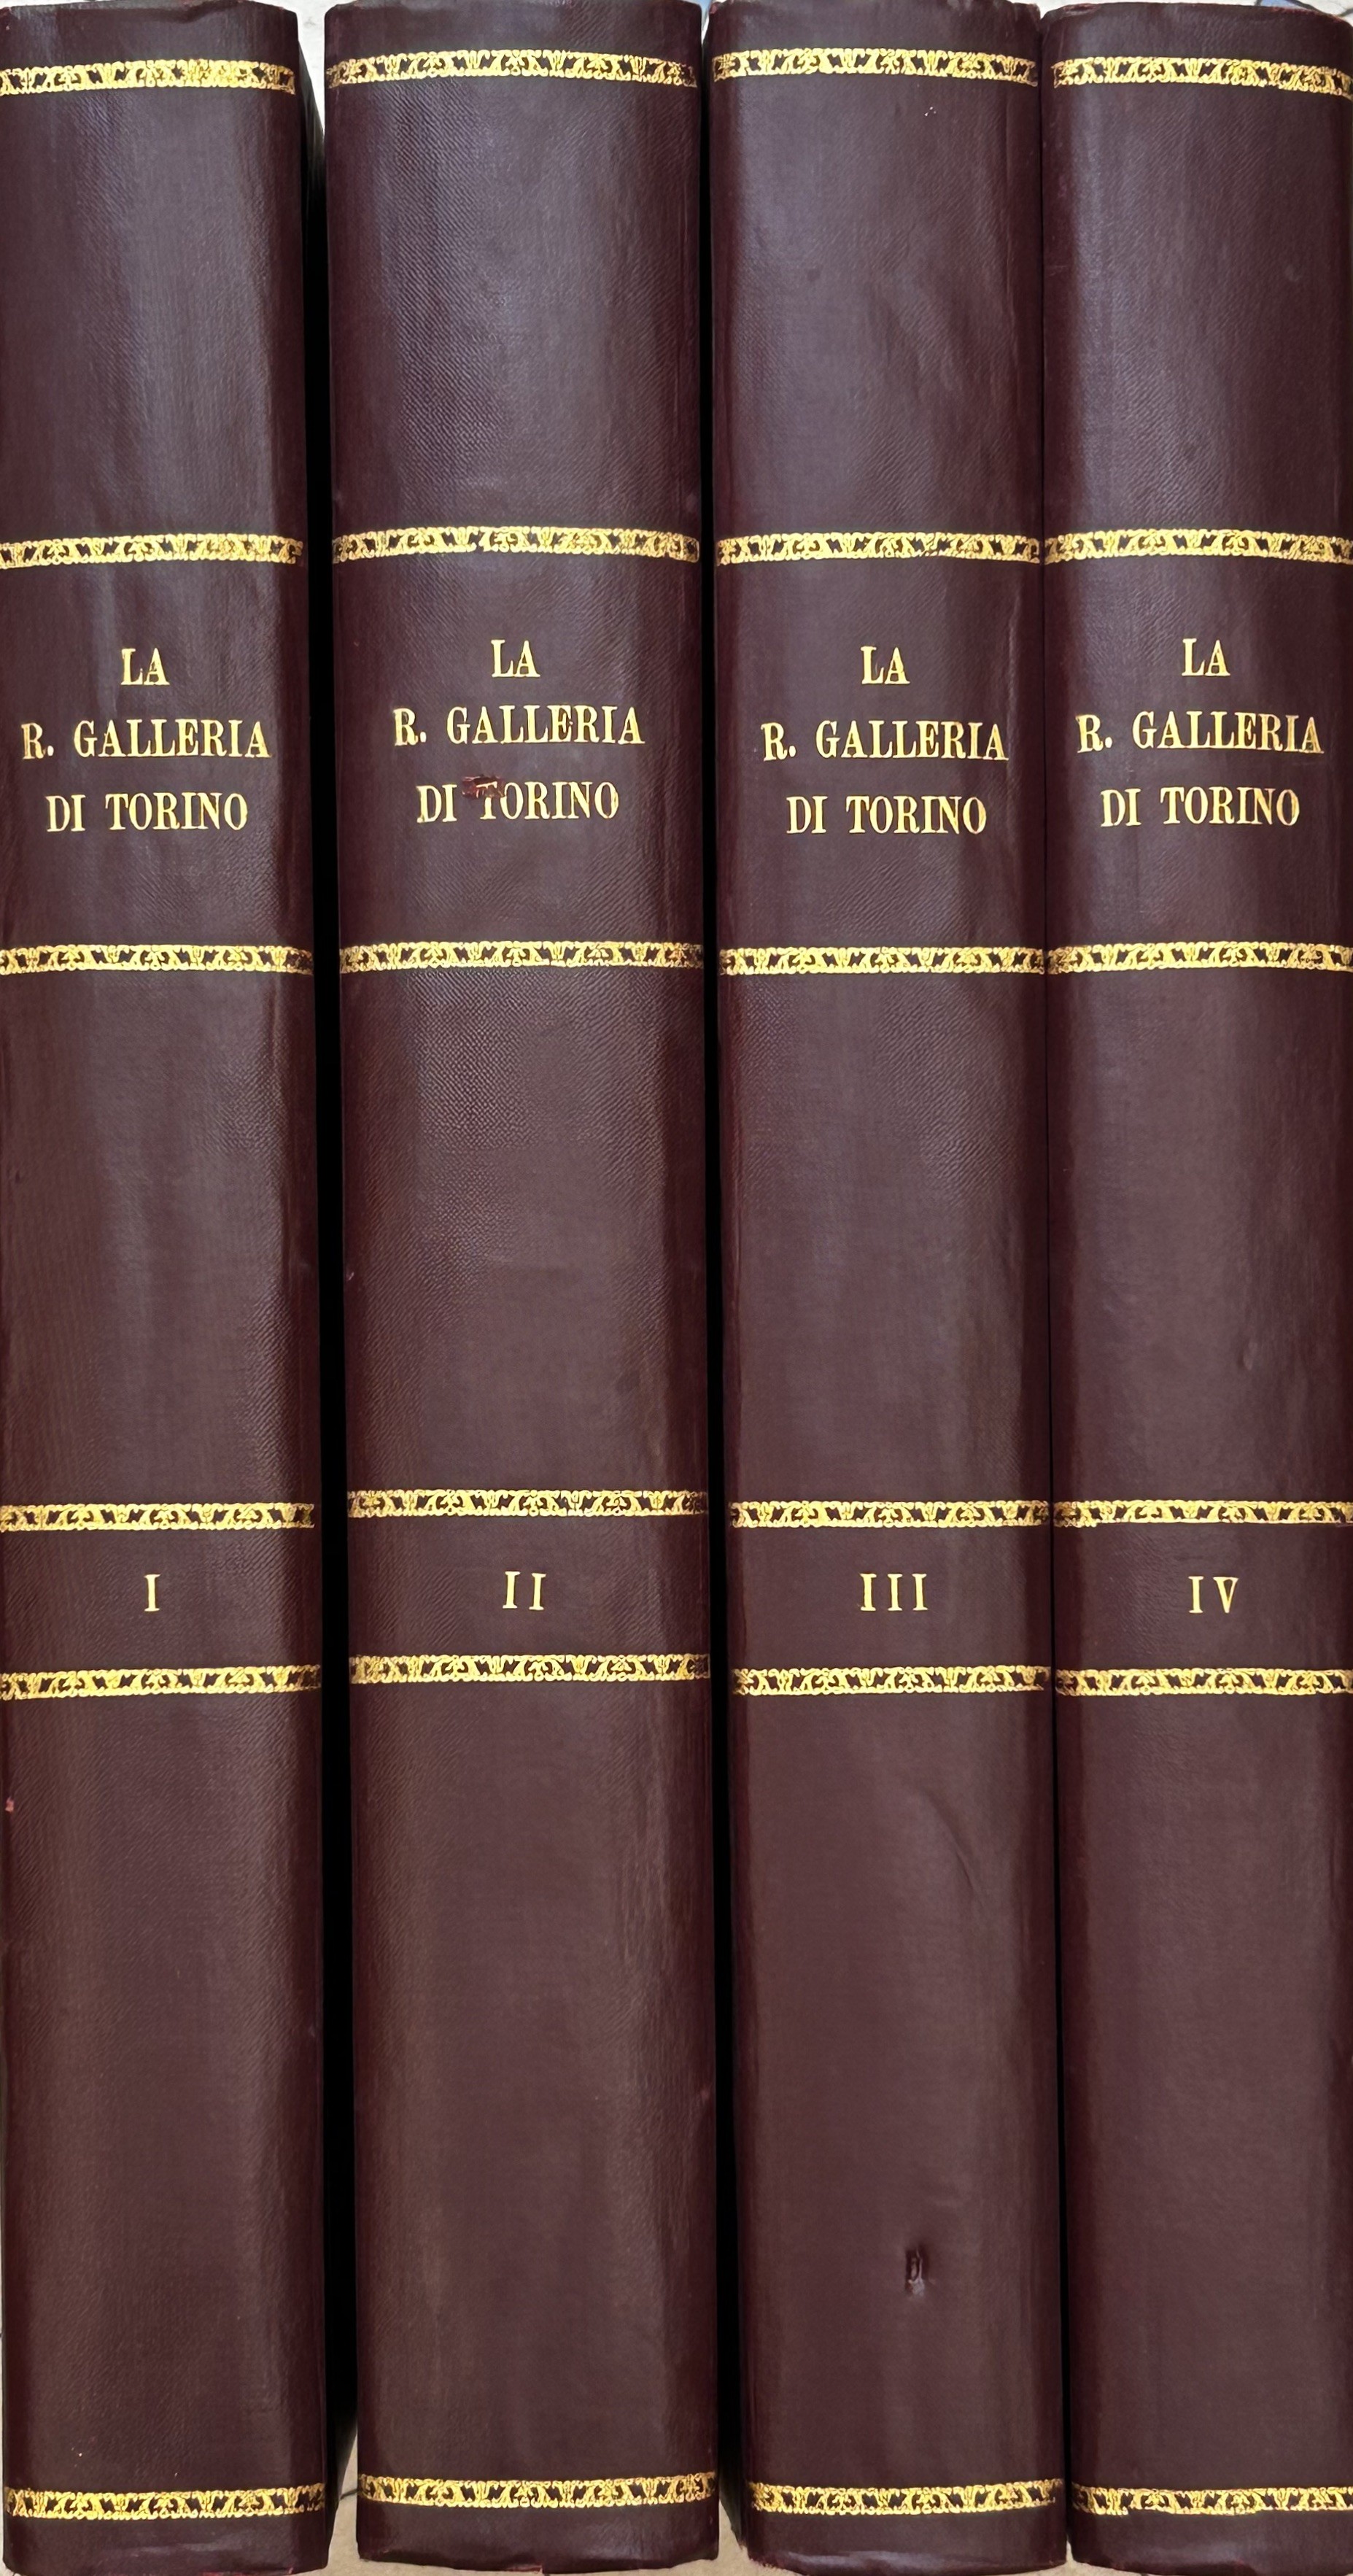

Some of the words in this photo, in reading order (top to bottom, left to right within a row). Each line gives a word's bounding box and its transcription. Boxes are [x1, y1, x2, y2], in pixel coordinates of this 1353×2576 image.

[120, 647, 170, 686] LA
[491, 639, 540, 678] LA
[861, 646, 910, 685] LA
[1182, 638, 1231, 677] LA
[21, 722, 55, 759] R.
[74, 719, 273, 759] GALLERIA
[392, 707, 427, 746] R.
[447, 705, 646, 746] GALLERIA
[761, 722, 796, 762] R.
[816, 720, 1009, 762] GALLERIA
[1076, 713, 1113, 754] R.
[1132, 711, 1325, 754] GALLERIA
[45, 794, 87, 832] DI
[105, 792, 249, 831] TORINO
[416, 784, 458, 824] DI
[786, 796, 829, 834] DI
[846, 796, 987, 835] TORINO
[1100, 788, 1142, 827] DI
[1160, 786, 1300, 827] TORINO
[144, 1574, 161, 1612] I
[502, 1571, 547, 1611] II
[860, 1573, 929, 1612] III
[1188, 1575, 1239, 1614] IV
